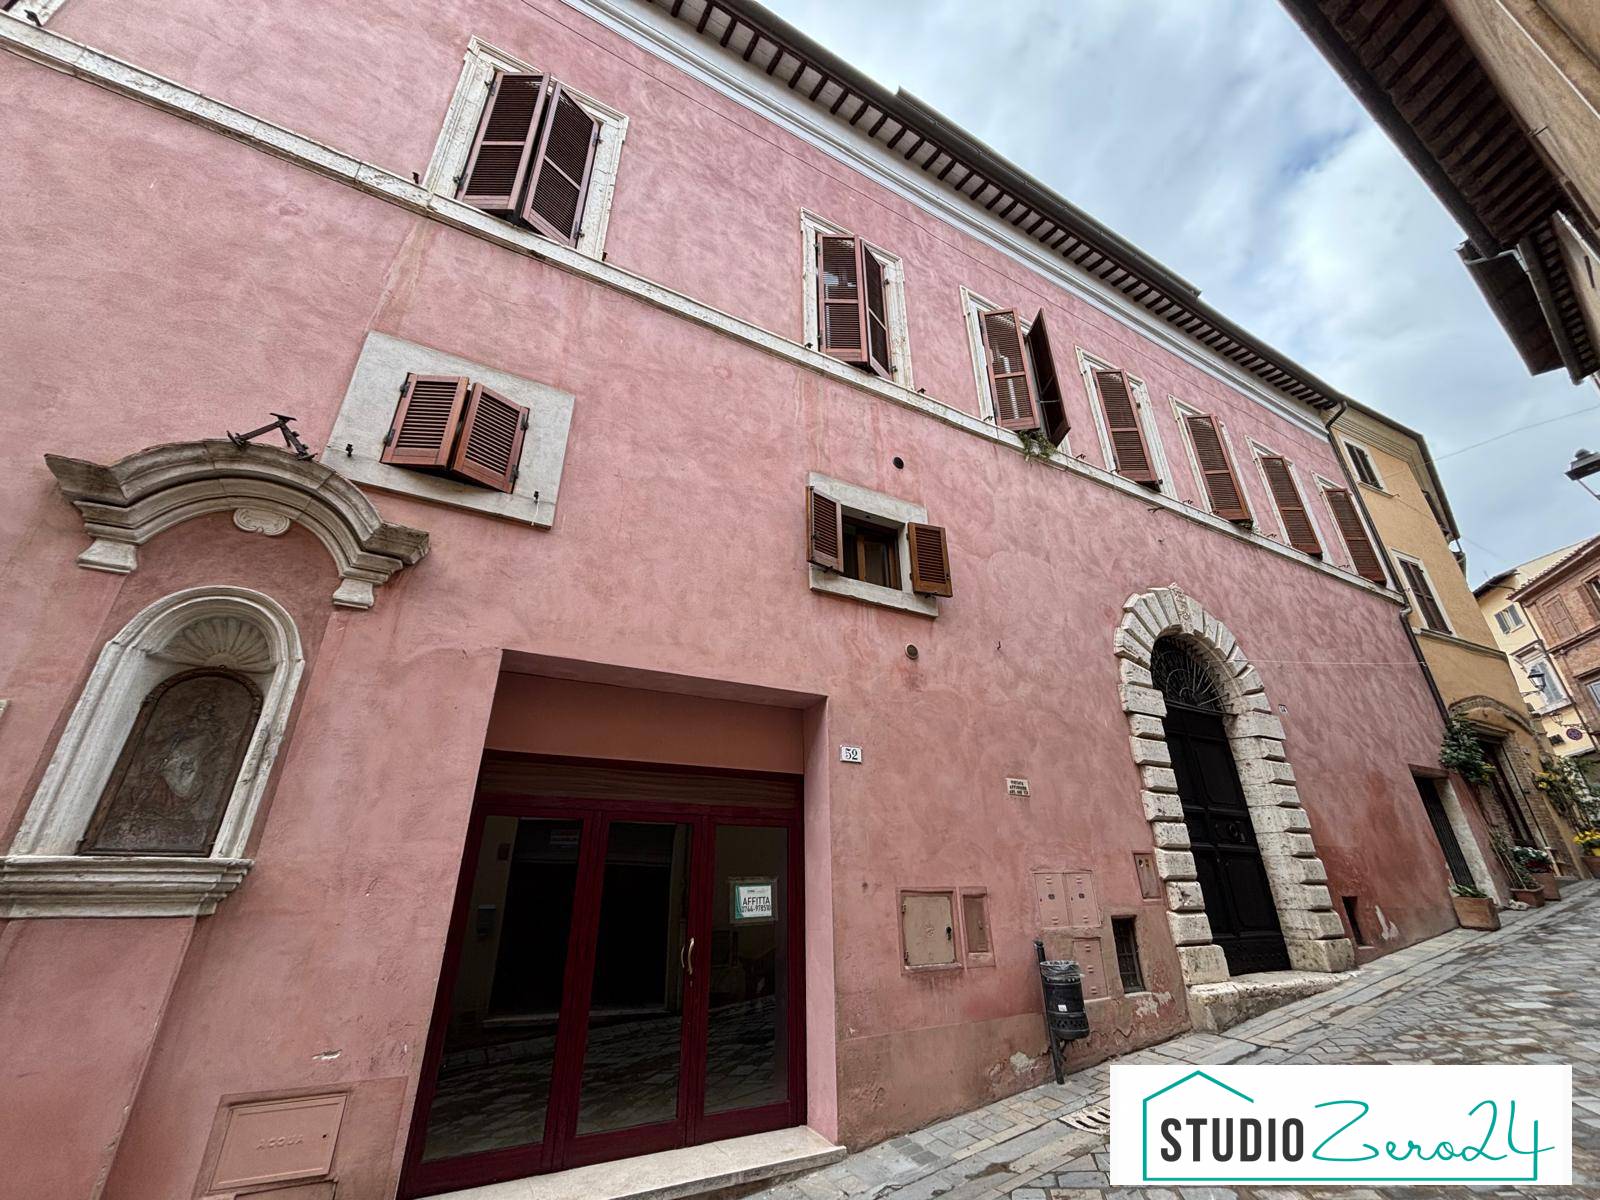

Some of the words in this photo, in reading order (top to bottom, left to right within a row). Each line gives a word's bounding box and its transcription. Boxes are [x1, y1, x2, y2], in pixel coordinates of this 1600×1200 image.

[845, 748, 858, 761] 52
[742, 896, 771, 906] AFFITTA
[256, 1134, 304, 1151] ACQUA
